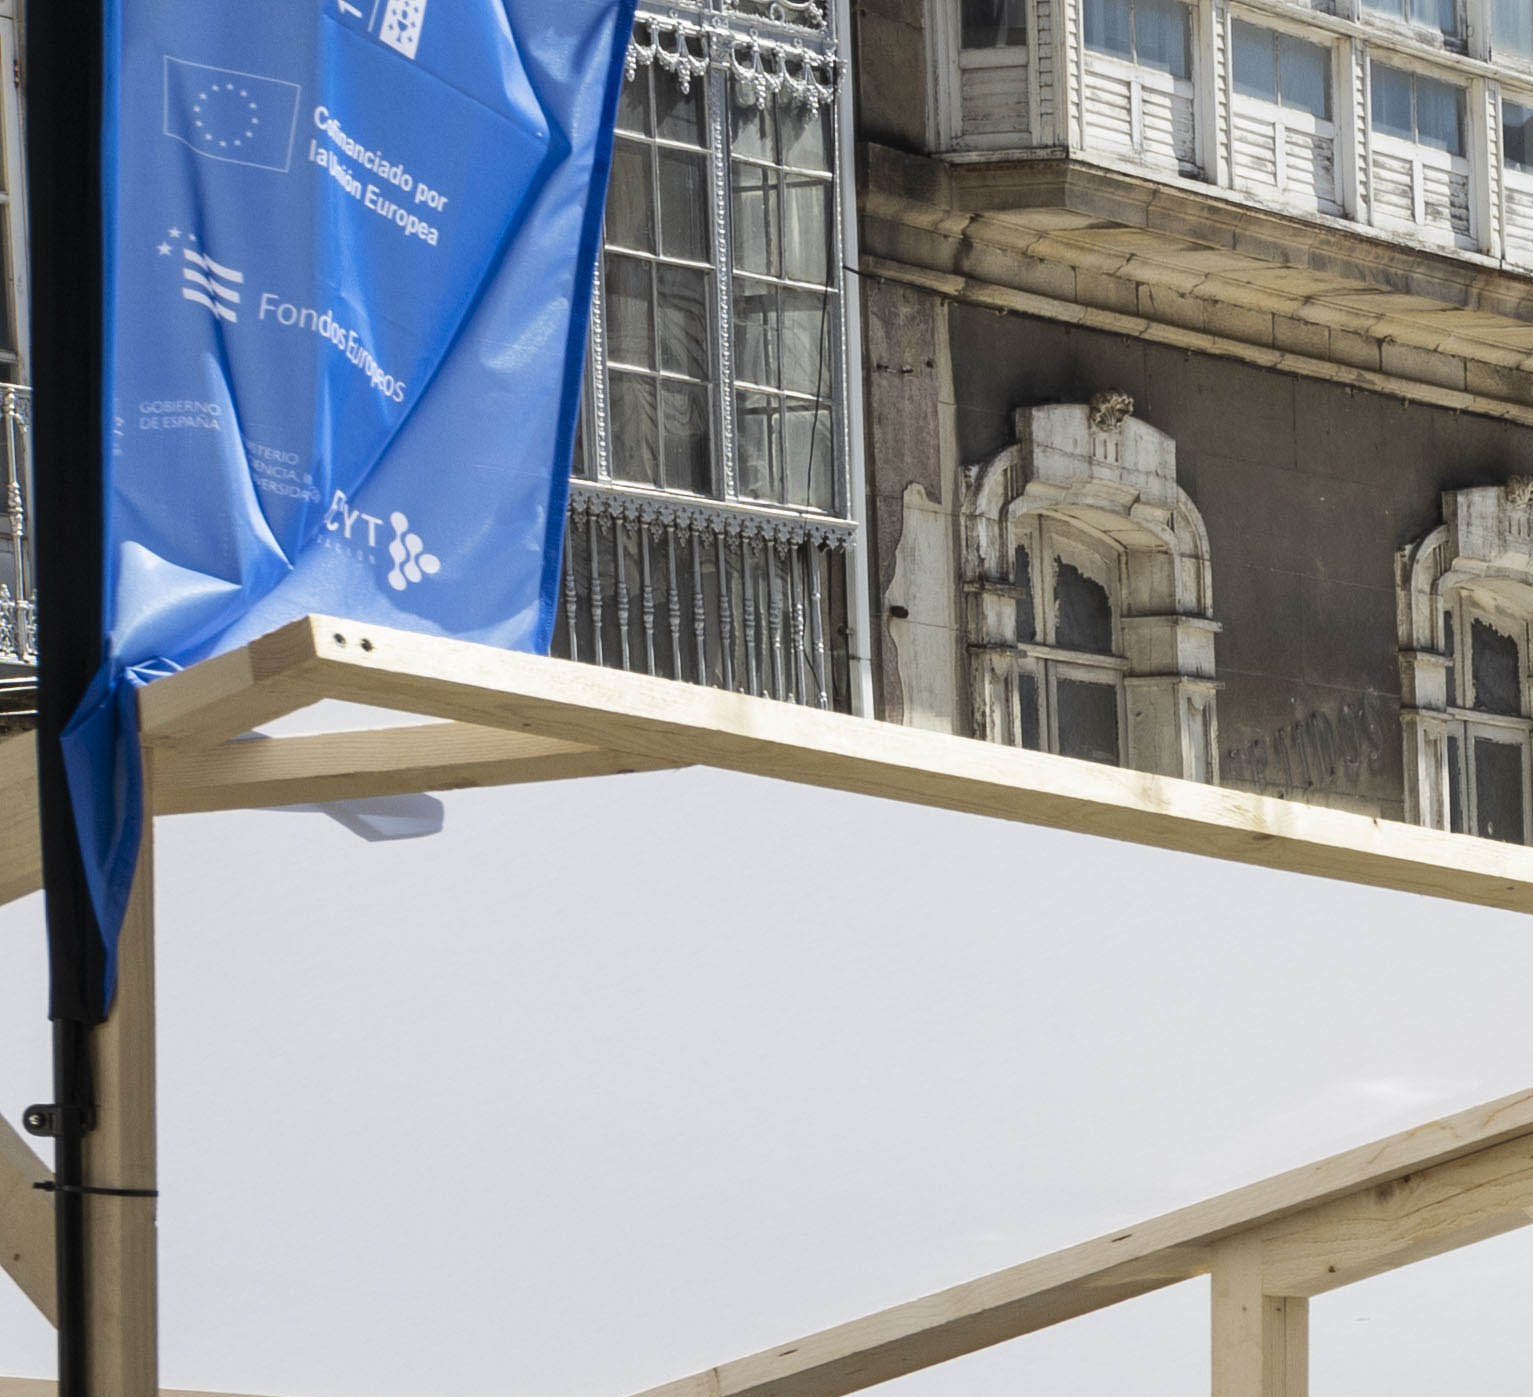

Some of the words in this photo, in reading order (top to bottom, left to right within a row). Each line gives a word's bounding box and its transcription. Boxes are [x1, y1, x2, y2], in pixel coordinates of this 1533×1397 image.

[308, 139, 329, 168] la
[364, 183, 440, 247] Europea
[413, 181, 448, 213] por
[259, 292, 347, 350] Fondos
[139, 401, 221, 416] GOBIERNO
[140, 416, 159, 430] DE
[161, 415, 221, 430] ESPAÑA
